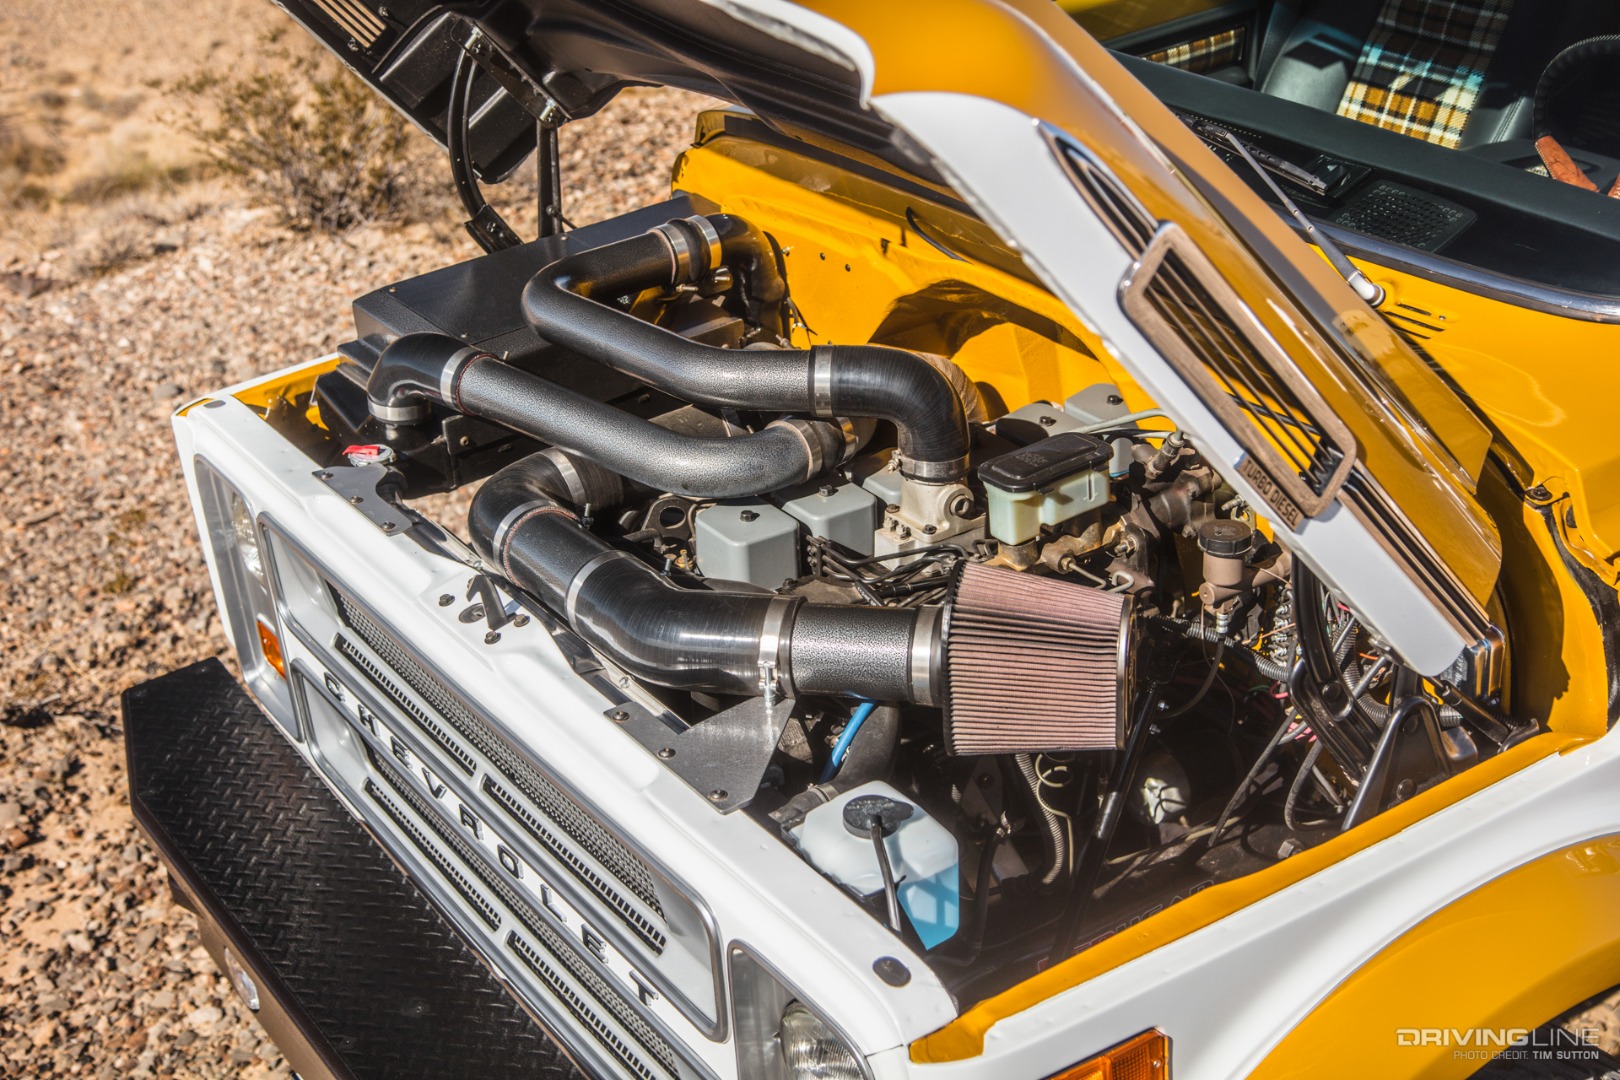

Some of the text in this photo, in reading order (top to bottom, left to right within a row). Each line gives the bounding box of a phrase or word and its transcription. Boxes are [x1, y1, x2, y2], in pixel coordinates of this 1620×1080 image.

[1243, 459, 1299, 526] TURBO DIESEL
[324, 671, 660, 1006] CHEVROLET
